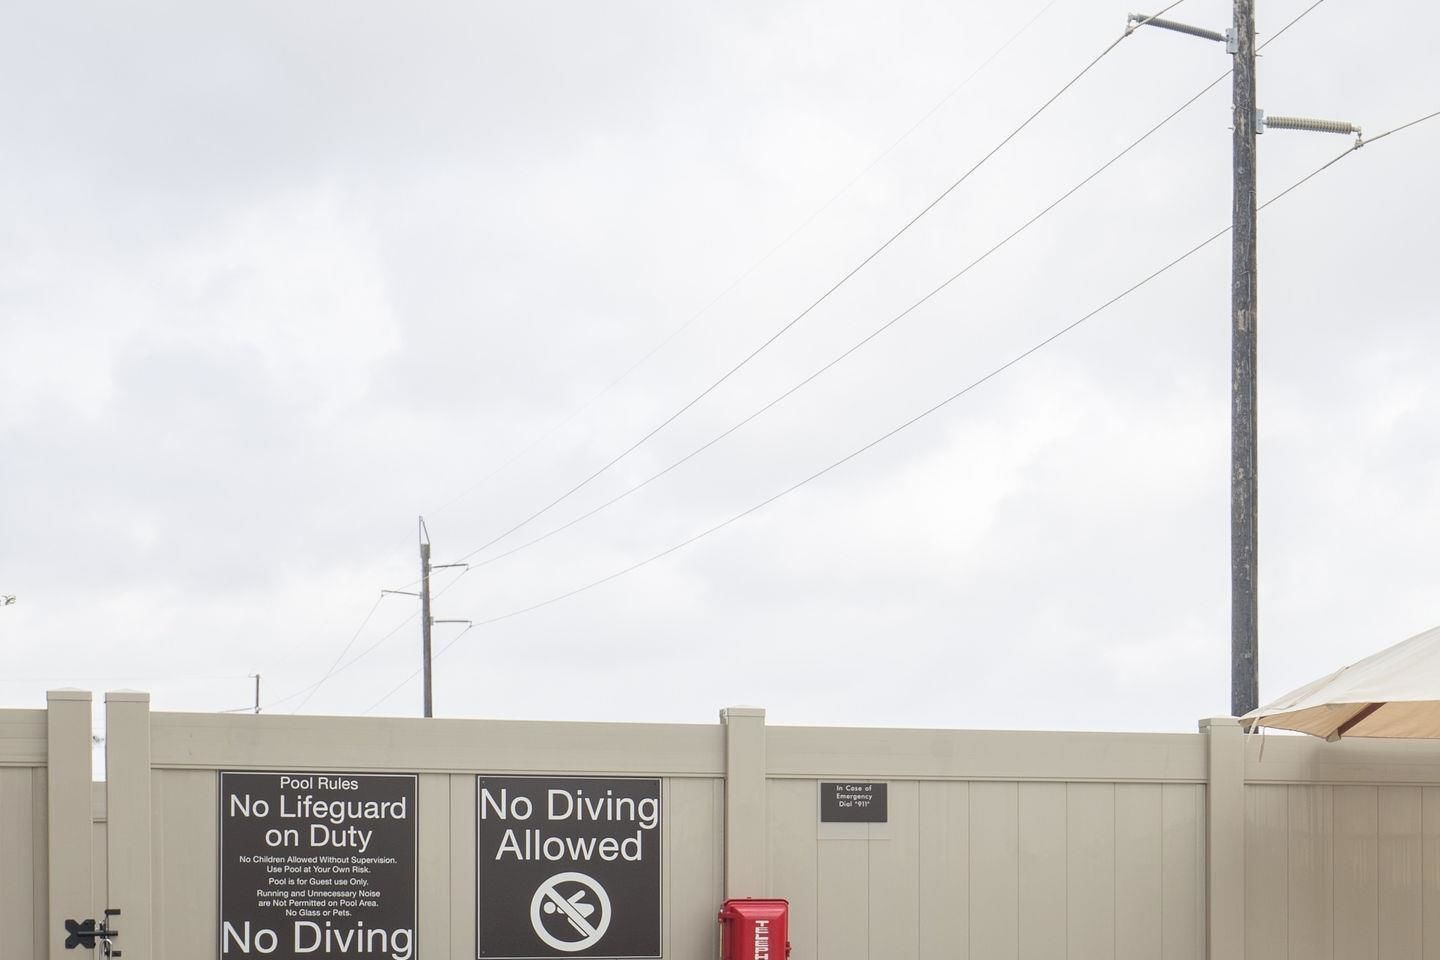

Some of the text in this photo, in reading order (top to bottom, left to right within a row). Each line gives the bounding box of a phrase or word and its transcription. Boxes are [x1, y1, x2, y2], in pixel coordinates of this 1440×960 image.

[280, 776, 359, 790] Pool Rules
[836, 793, 873, 801] Emergency
[231, 794, 406, 824] No Lifeguard
[481, 788, 658, 830] No Diving
[265, 824, 373, 853] on Duty
[495, 829, 642, 861] Allowed
[239, 855, 251, 863] No
[252, 855, 285, 863] Children
[319, 856, 349, 864] Without
[351, 856, 397, 865] Supervision.
[267, 865, 282, 873] Use
[284, 865, 302, 873] Pool
[313, 865, 331, 873] Your
[332, 865, 350, 873] Own
[352, 866, 371, 874] Risk.
[268, 877, 287, 885] Pool
[288, 877, 295, 885] is
[309, 877, 332, 885] Guest
[257, 889, 289, 899] Running
[307, 889, 357, 899] Unnecessary
[272, 899, 287, 907] Not
[289, 899, 326, 907] Permitted
[340, 899, 357, 907] Pool
[358, 899, 379, 907] Area.
[298, 908, 321, 917] Glass
[332, 908, 352, 916] Pets.
[223, 921, 413, 960] No Diving
